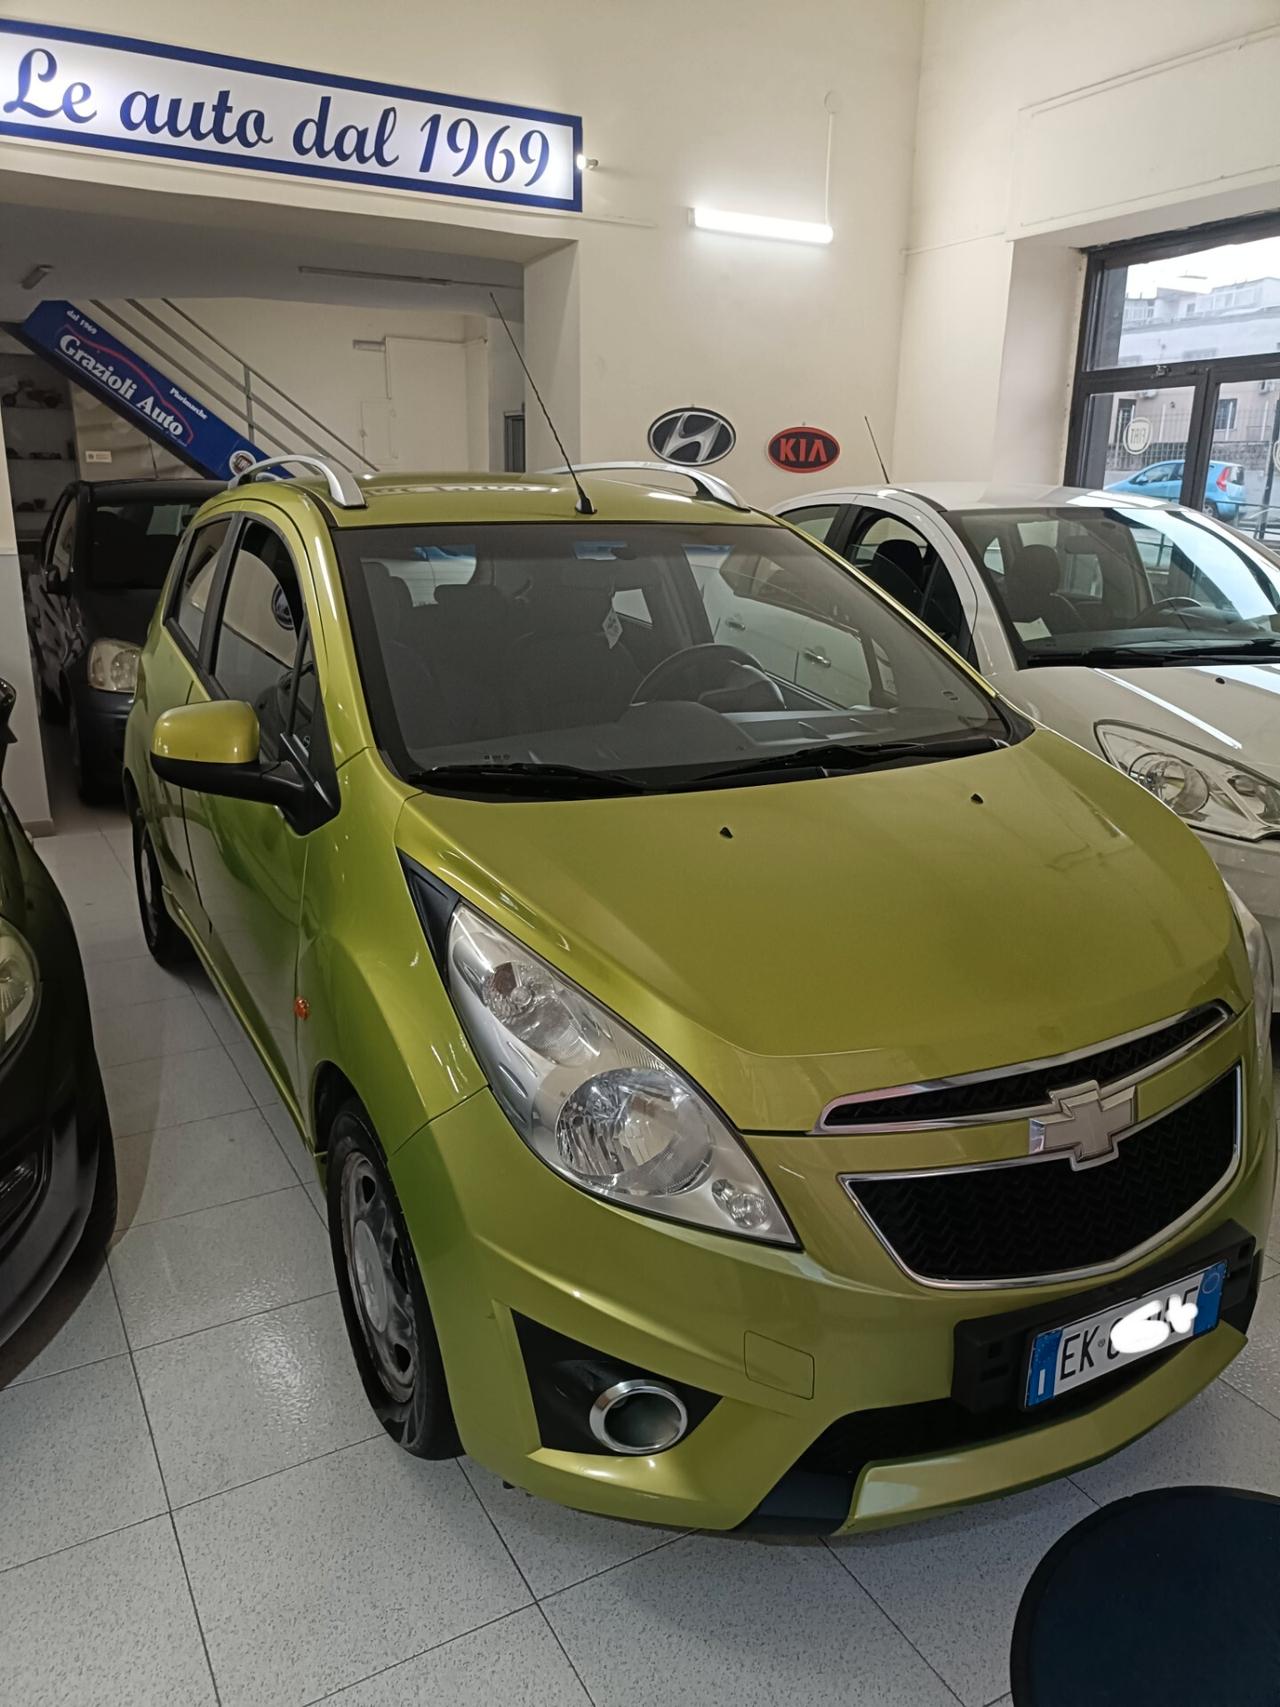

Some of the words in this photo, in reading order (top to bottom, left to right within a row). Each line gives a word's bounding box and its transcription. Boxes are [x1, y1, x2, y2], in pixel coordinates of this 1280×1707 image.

[3, 48, 97, 123] Le
[120, 91, 273, 149] auto
[293, 97, 400, 168] dal
[420, 114, 551, 188] 1969
[66, 310, 80, 321] dal
[60, 335, 137, 400] Grazioli
[136, 396, 183, 436] Auto
[780, 439, 827, 461] KIA
